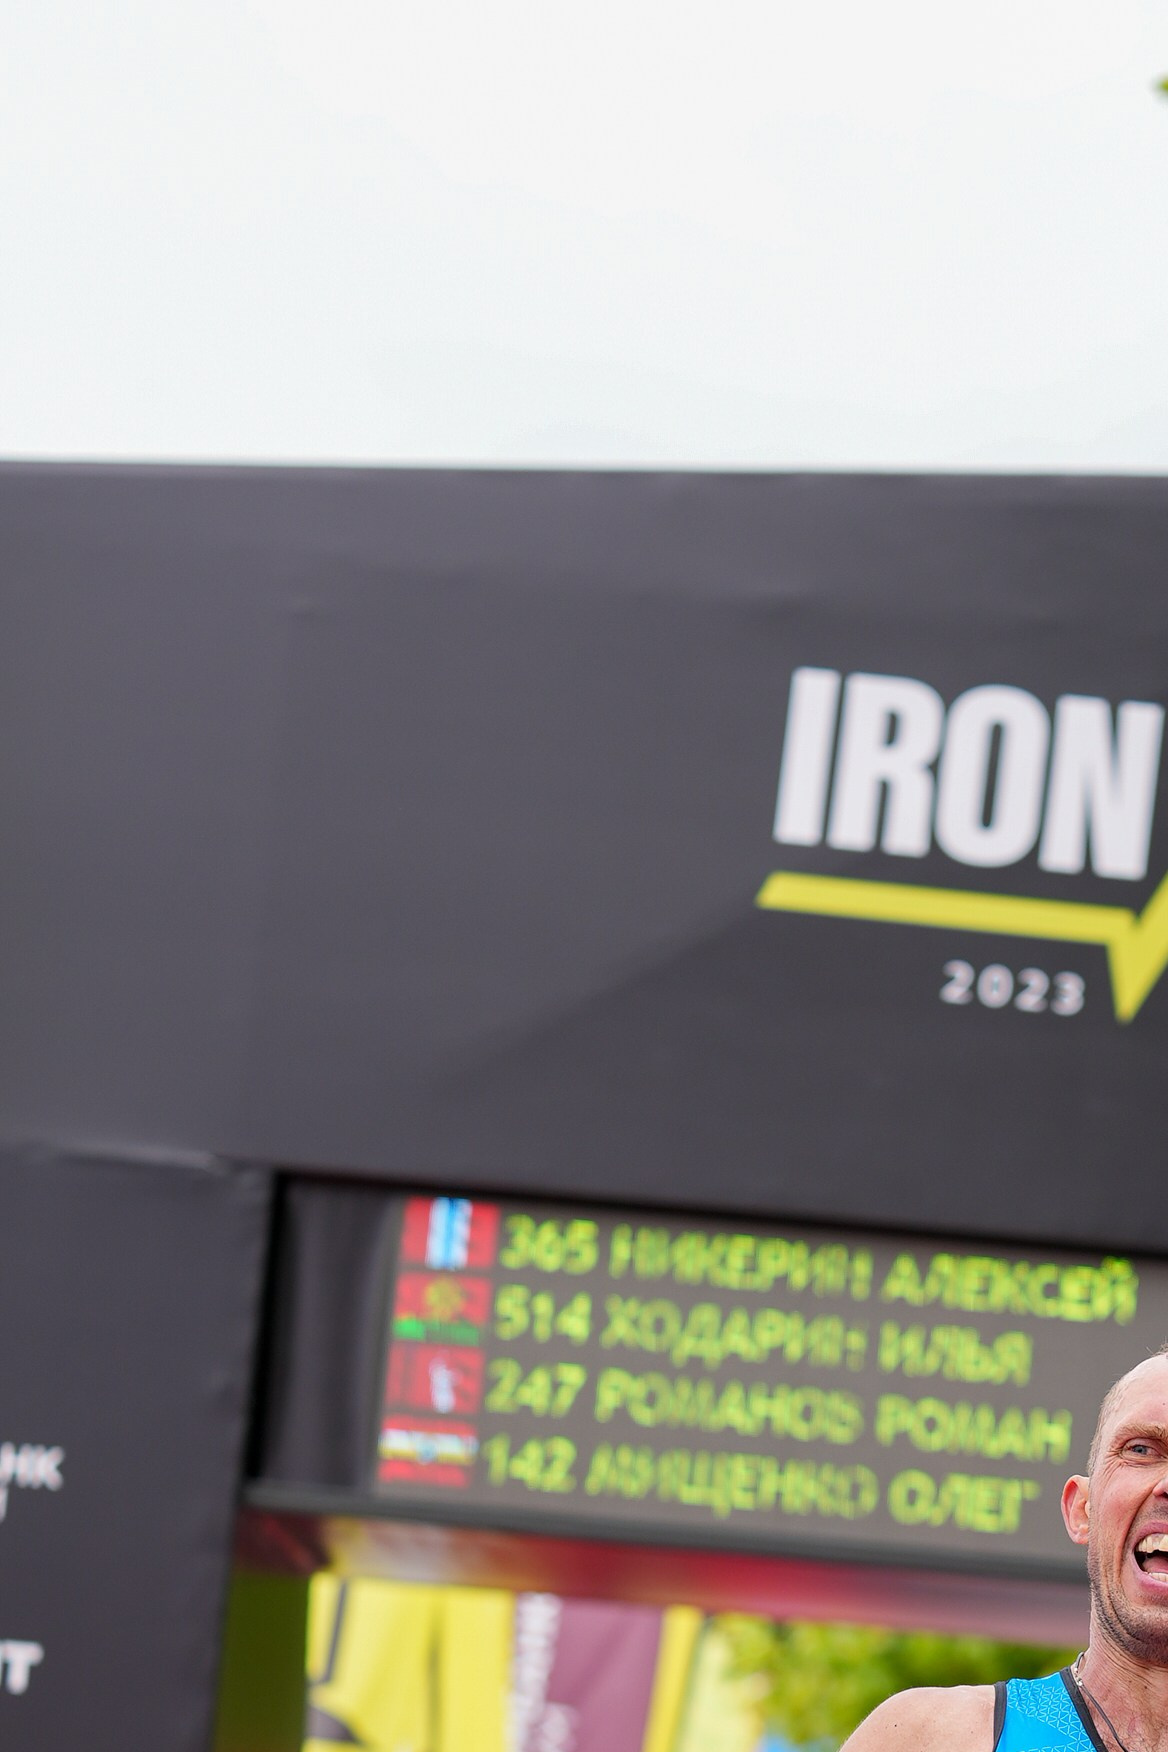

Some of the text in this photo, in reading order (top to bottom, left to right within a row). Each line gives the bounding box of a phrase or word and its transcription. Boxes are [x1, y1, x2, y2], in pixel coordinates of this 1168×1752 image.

[773, 666, 1166, 881] IRON
[939, 960, 1086, 1016] 2023
[495, 1283, 592, 1347] 514
[502, 1213, 599, 1276] 365
[880, 1252, 1139, 1327] АЛЕКСЕЙ
[484, 1356, 587, 1420] 247
[875, 1392, 1073, 1466] РОМАН
[482, 1431, 578, 1494] 142
[887, 1467, 1041, 1535] ОЛЕГ
